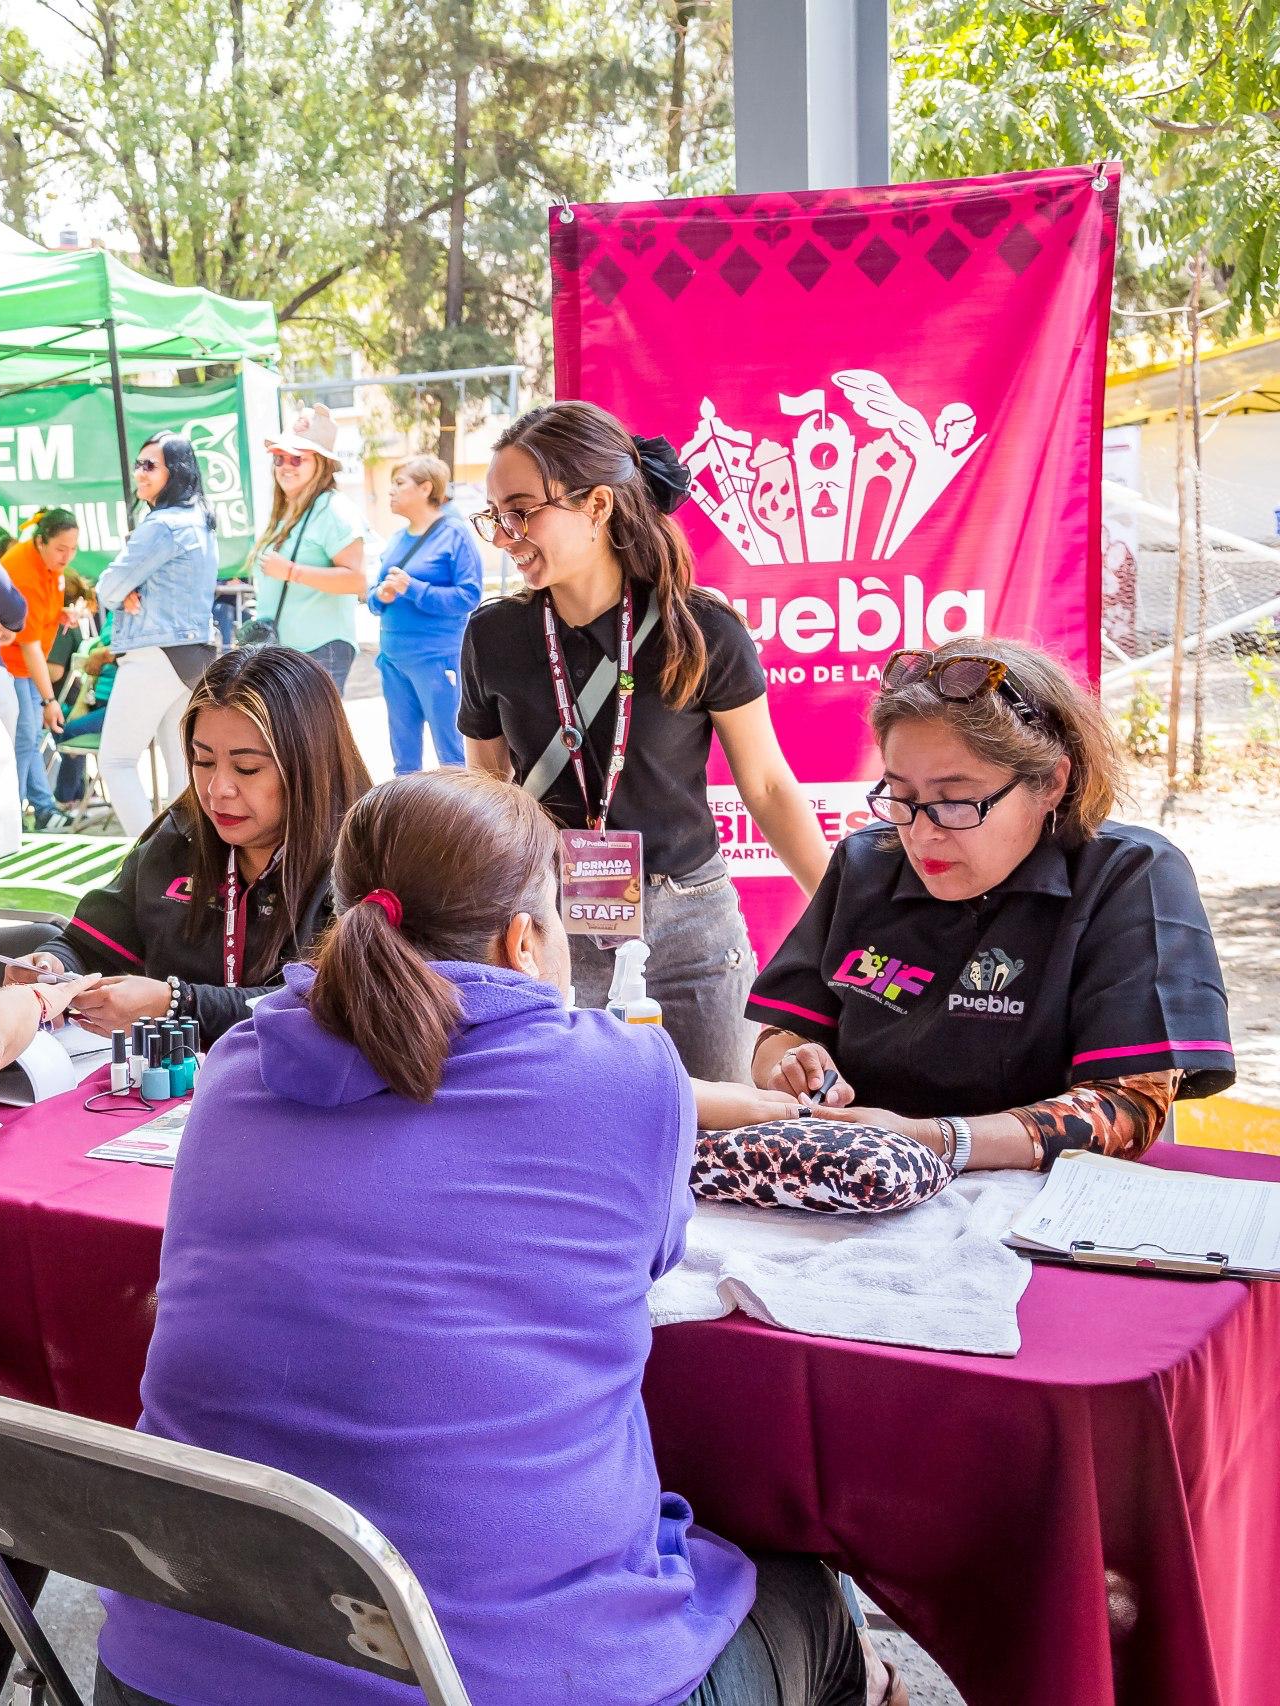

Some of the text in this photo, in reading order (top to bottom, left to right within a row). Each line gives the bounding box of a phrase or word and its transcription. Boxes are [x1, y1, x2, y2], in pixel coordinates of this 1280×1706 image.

[696, 574, 986, 654] uebla
[812, 666, 845, 683] DE
[851, 664, 883, 682] LA
[570, 859, 632, 877] JORNADA
[570, 904, 635, 920] STAFF
[948, 993, 1025, 1015] Puebla
